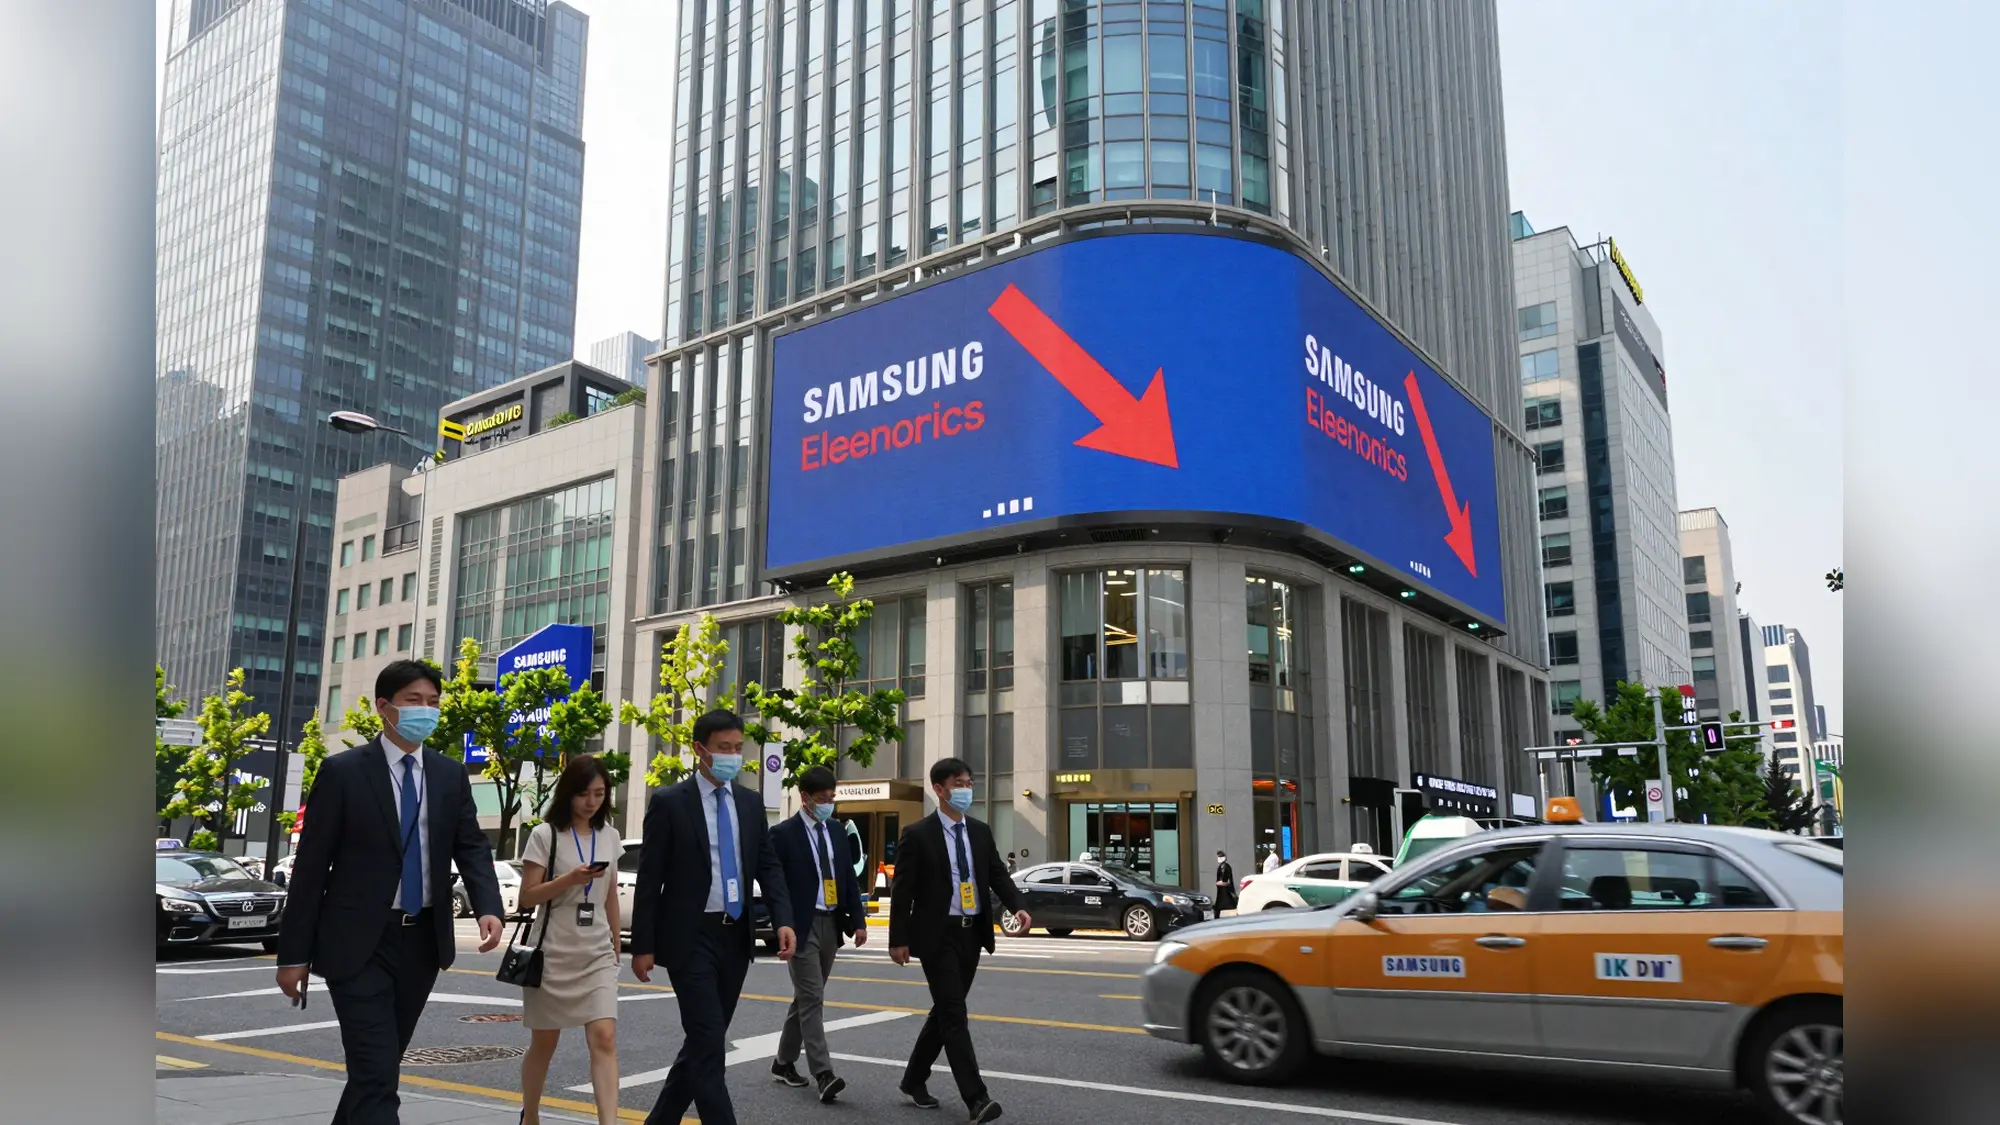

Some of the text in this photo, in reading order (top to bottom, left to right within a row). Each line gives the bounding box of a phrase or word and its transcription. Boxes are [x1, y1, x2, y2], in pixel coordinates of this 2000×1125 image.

[803, 341, 984, 424] SAMSUNG
[1305, 334, 1405, 436] SAMSUNG
[802, 400, 985, 471] Eleenorics
[1386, 957, 1461, 973] SAMSUNG
